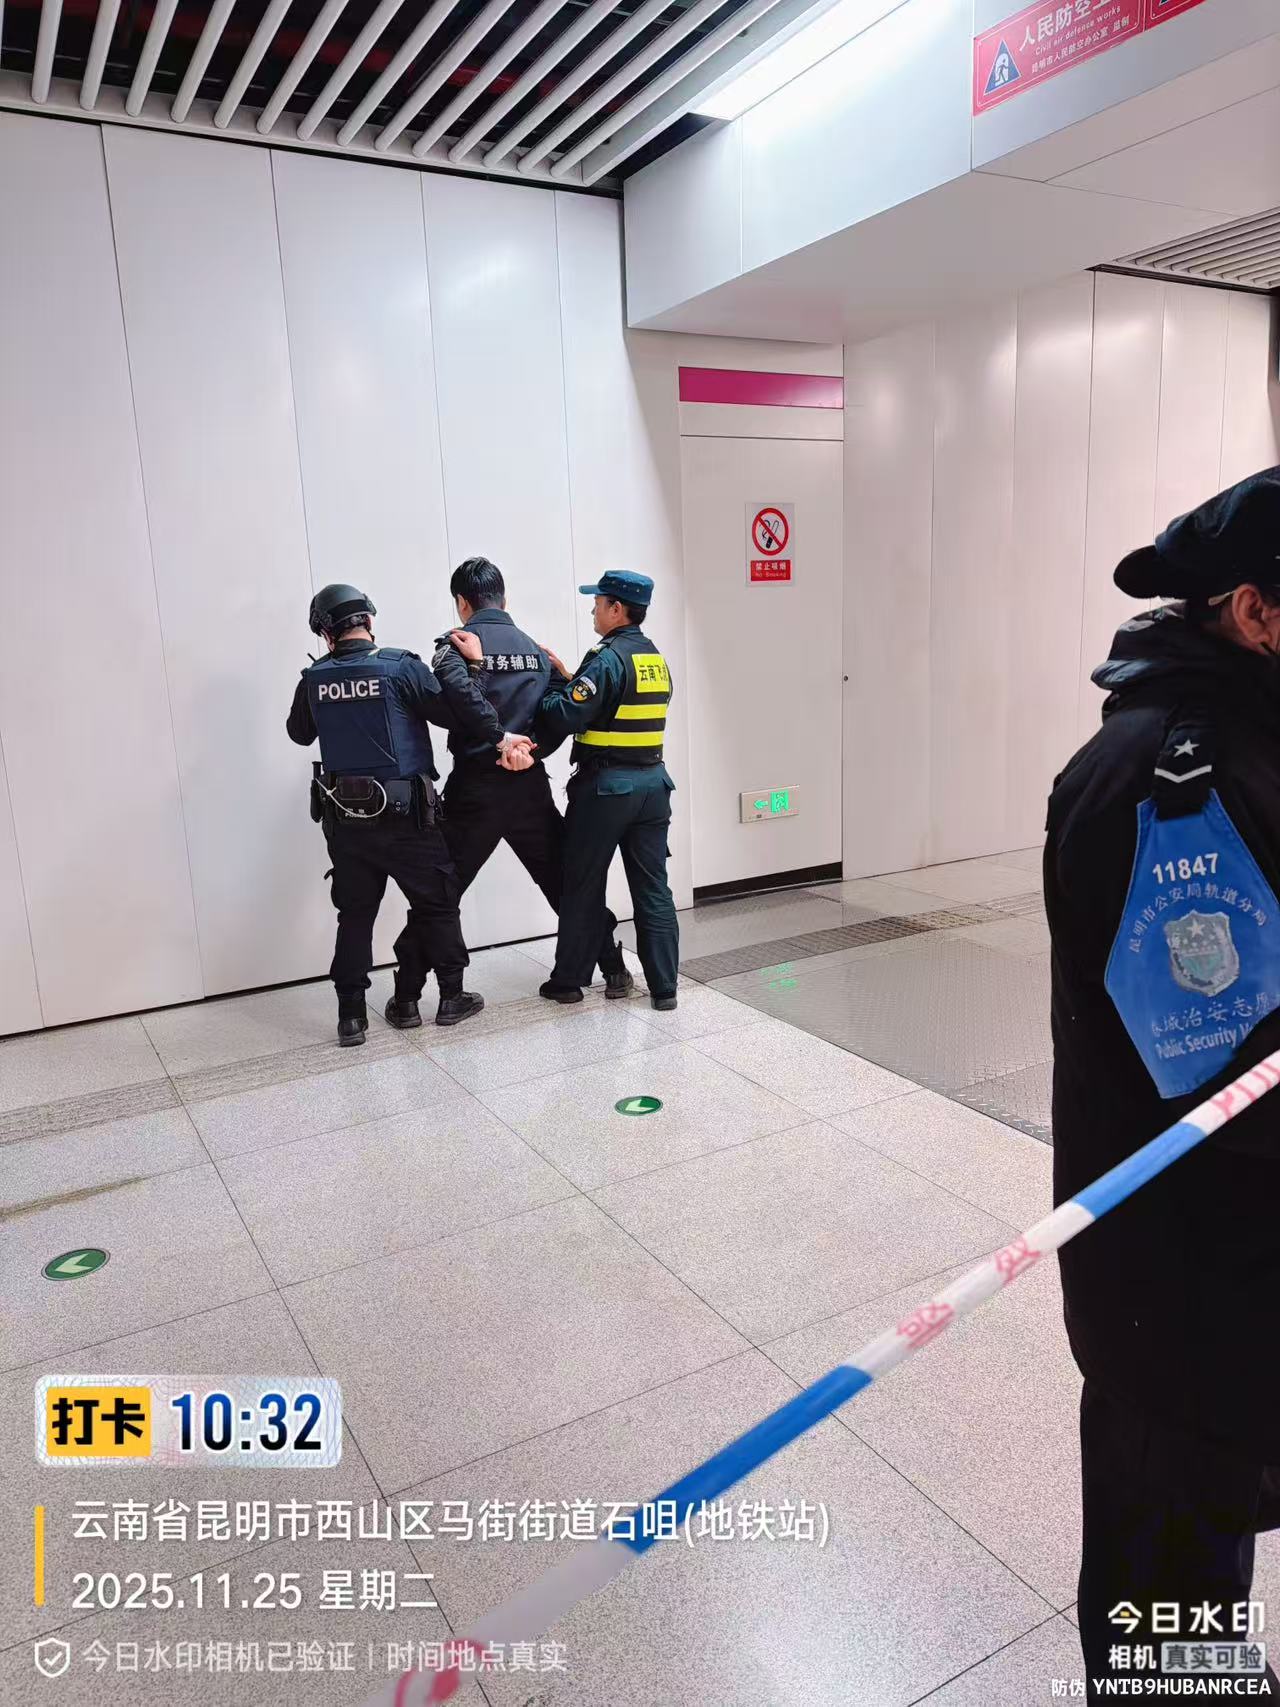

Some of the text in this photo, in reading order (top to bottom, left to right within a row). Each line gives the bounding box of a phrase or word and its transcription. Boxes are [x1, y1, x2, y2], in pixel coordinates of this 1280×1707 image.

[1019, 0, 1112, 52] 人民防空
[1035, 6, 1121, 55] Civil air defence works
[755, 562, 787, 570] 禁止吸烟
[484, 654, 539, 670] 警务辅助
[318, 679, 380, 701] POLICE
[1152, 853, 1219, 884] 11847
[1129, 883, 1267, 953] 昆明市公安局轨道分局
[1155, 1039, 1186, 1059] Public
[1185, 1026, 1238, 1053] Security
